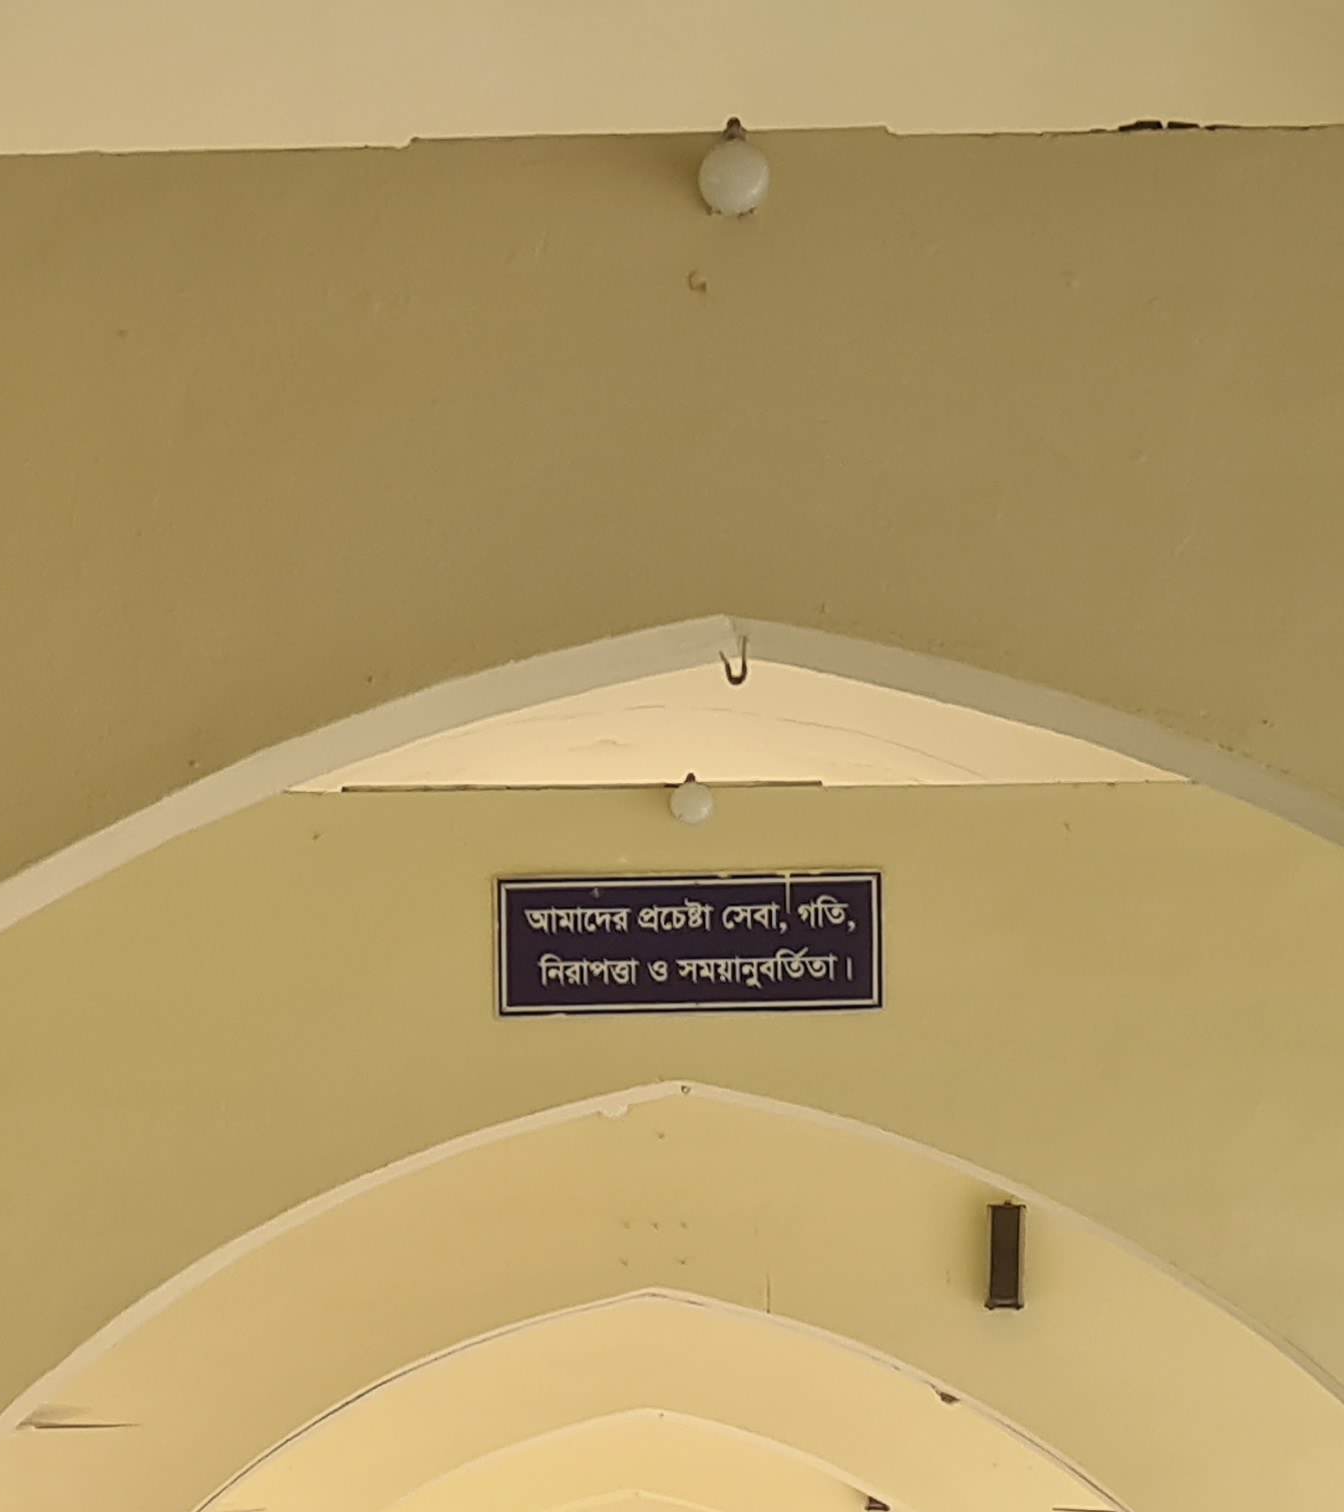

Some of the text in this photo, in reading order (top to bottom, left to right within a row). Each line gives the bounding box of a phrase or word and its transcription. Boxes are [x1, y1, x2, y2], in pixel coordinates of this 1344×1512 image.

[524, 895, 857, 934] আমাদের প্রচেষ্টা সেবা, গতি,
[538, 952, 640, 986] নিরাপত্তা
[647, 960, 669, 981] ও
[676, 946, 839, 989] সময়ানুবর্তিতা
